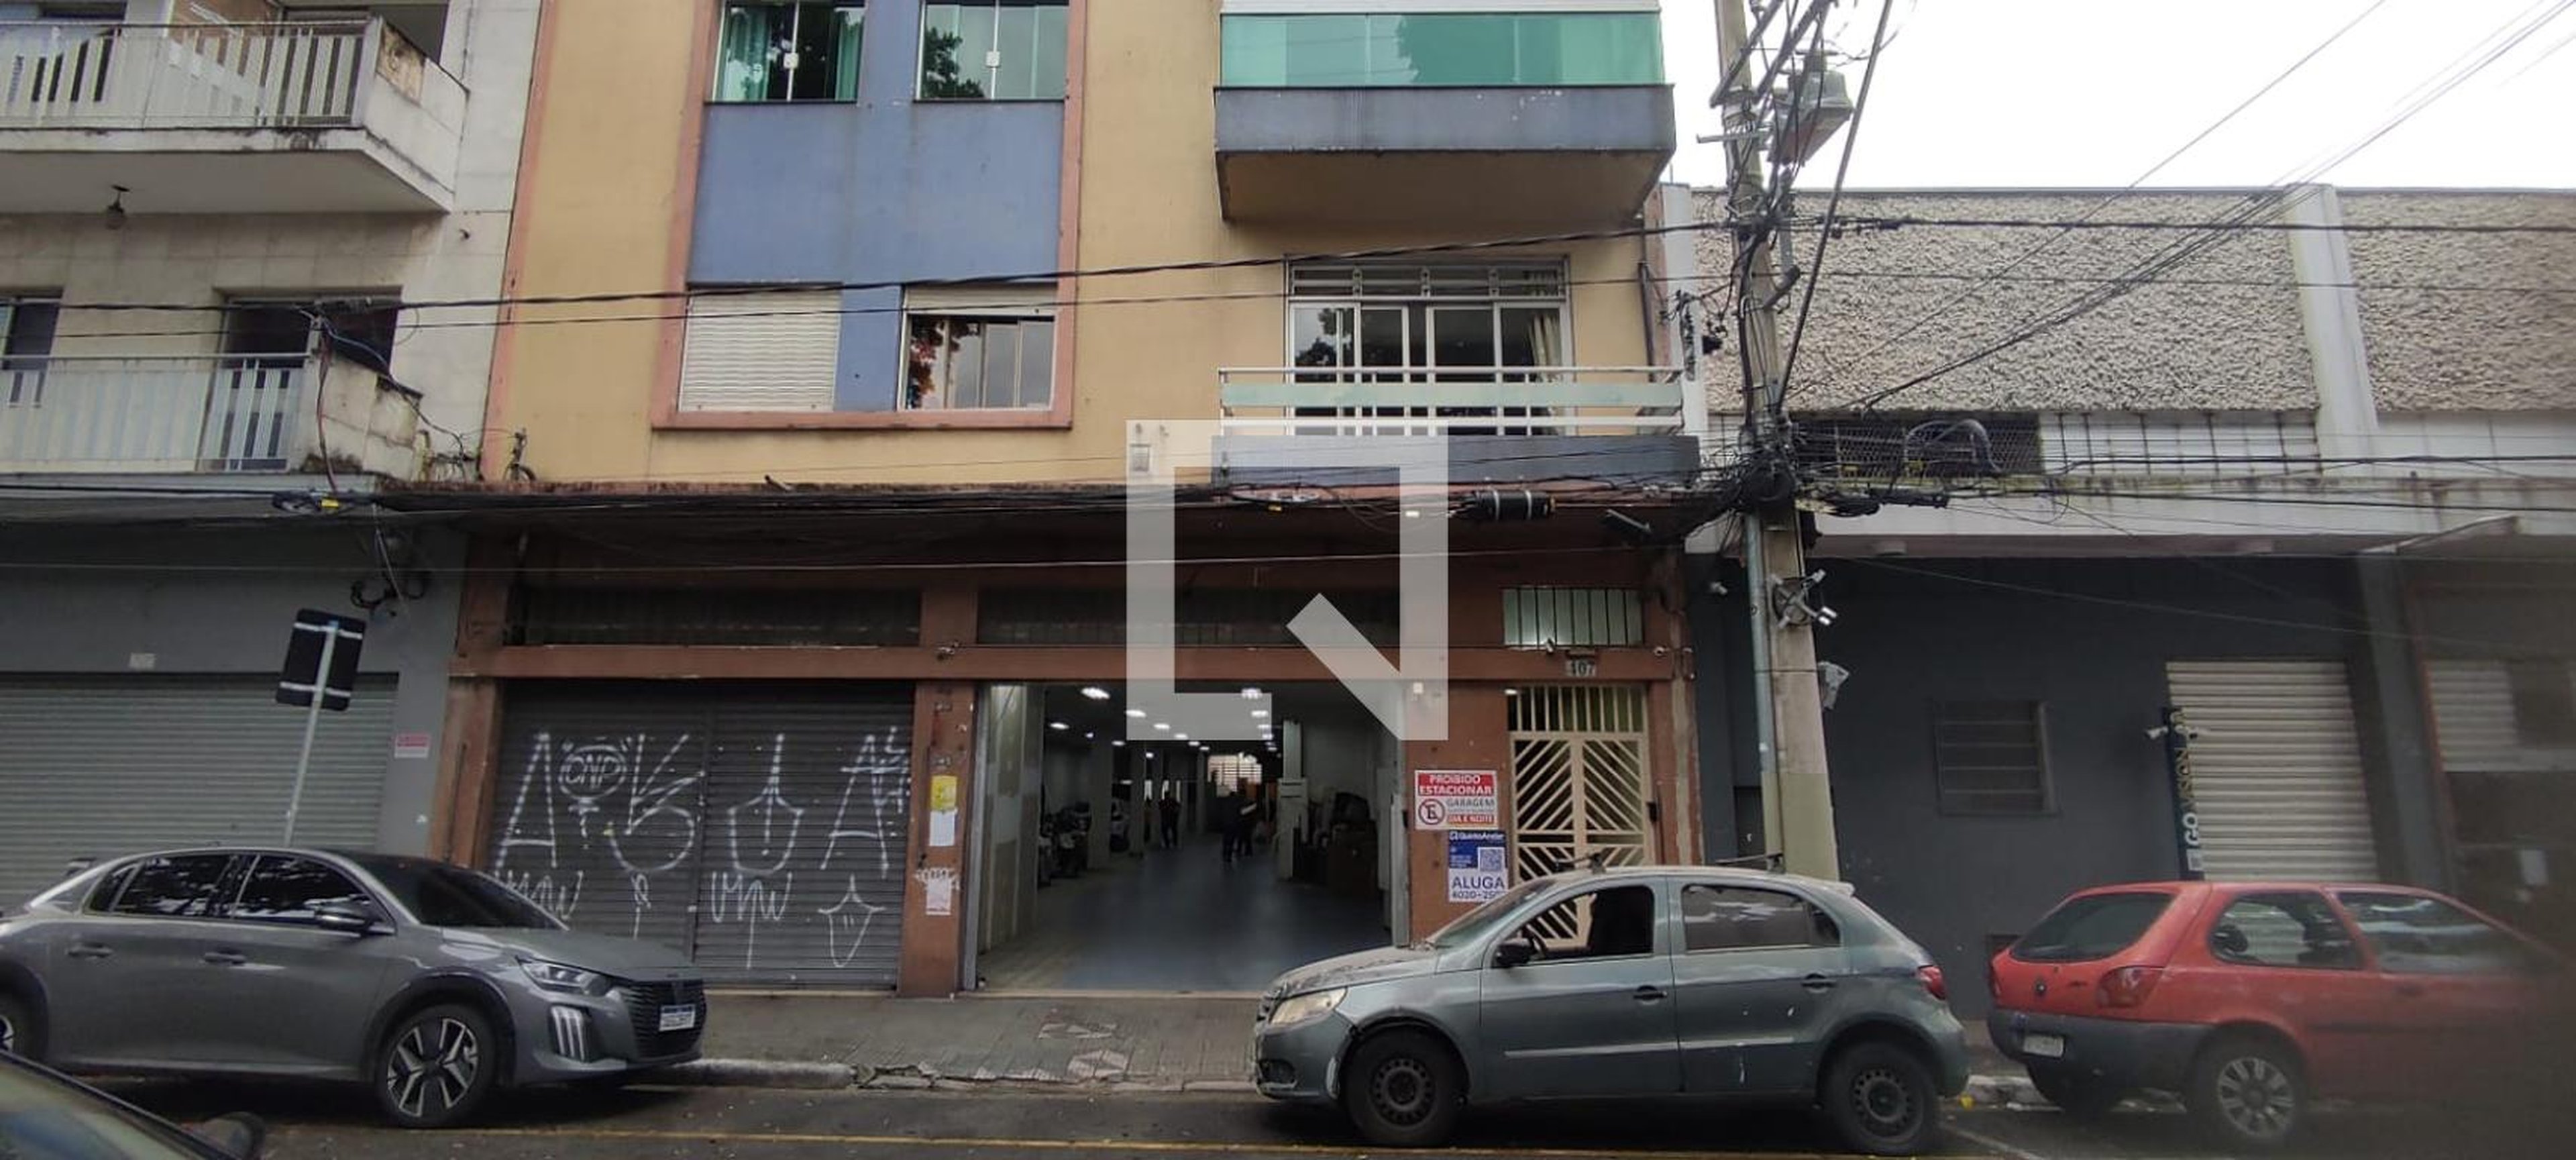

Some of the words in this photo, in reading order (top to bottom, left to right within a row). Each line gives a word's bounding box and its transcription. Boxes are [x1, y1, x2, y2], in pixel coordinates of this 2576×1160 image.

[1430, 774, 1481, 785] PROIBIDO
[1419, 785, 1492, 795] ESTACIONAR
[1446, 798, 1495, 806] GARAGEM
[2182, 812, 2200, 846] GO
[1452, 876, 1504, 889] ALUGA
